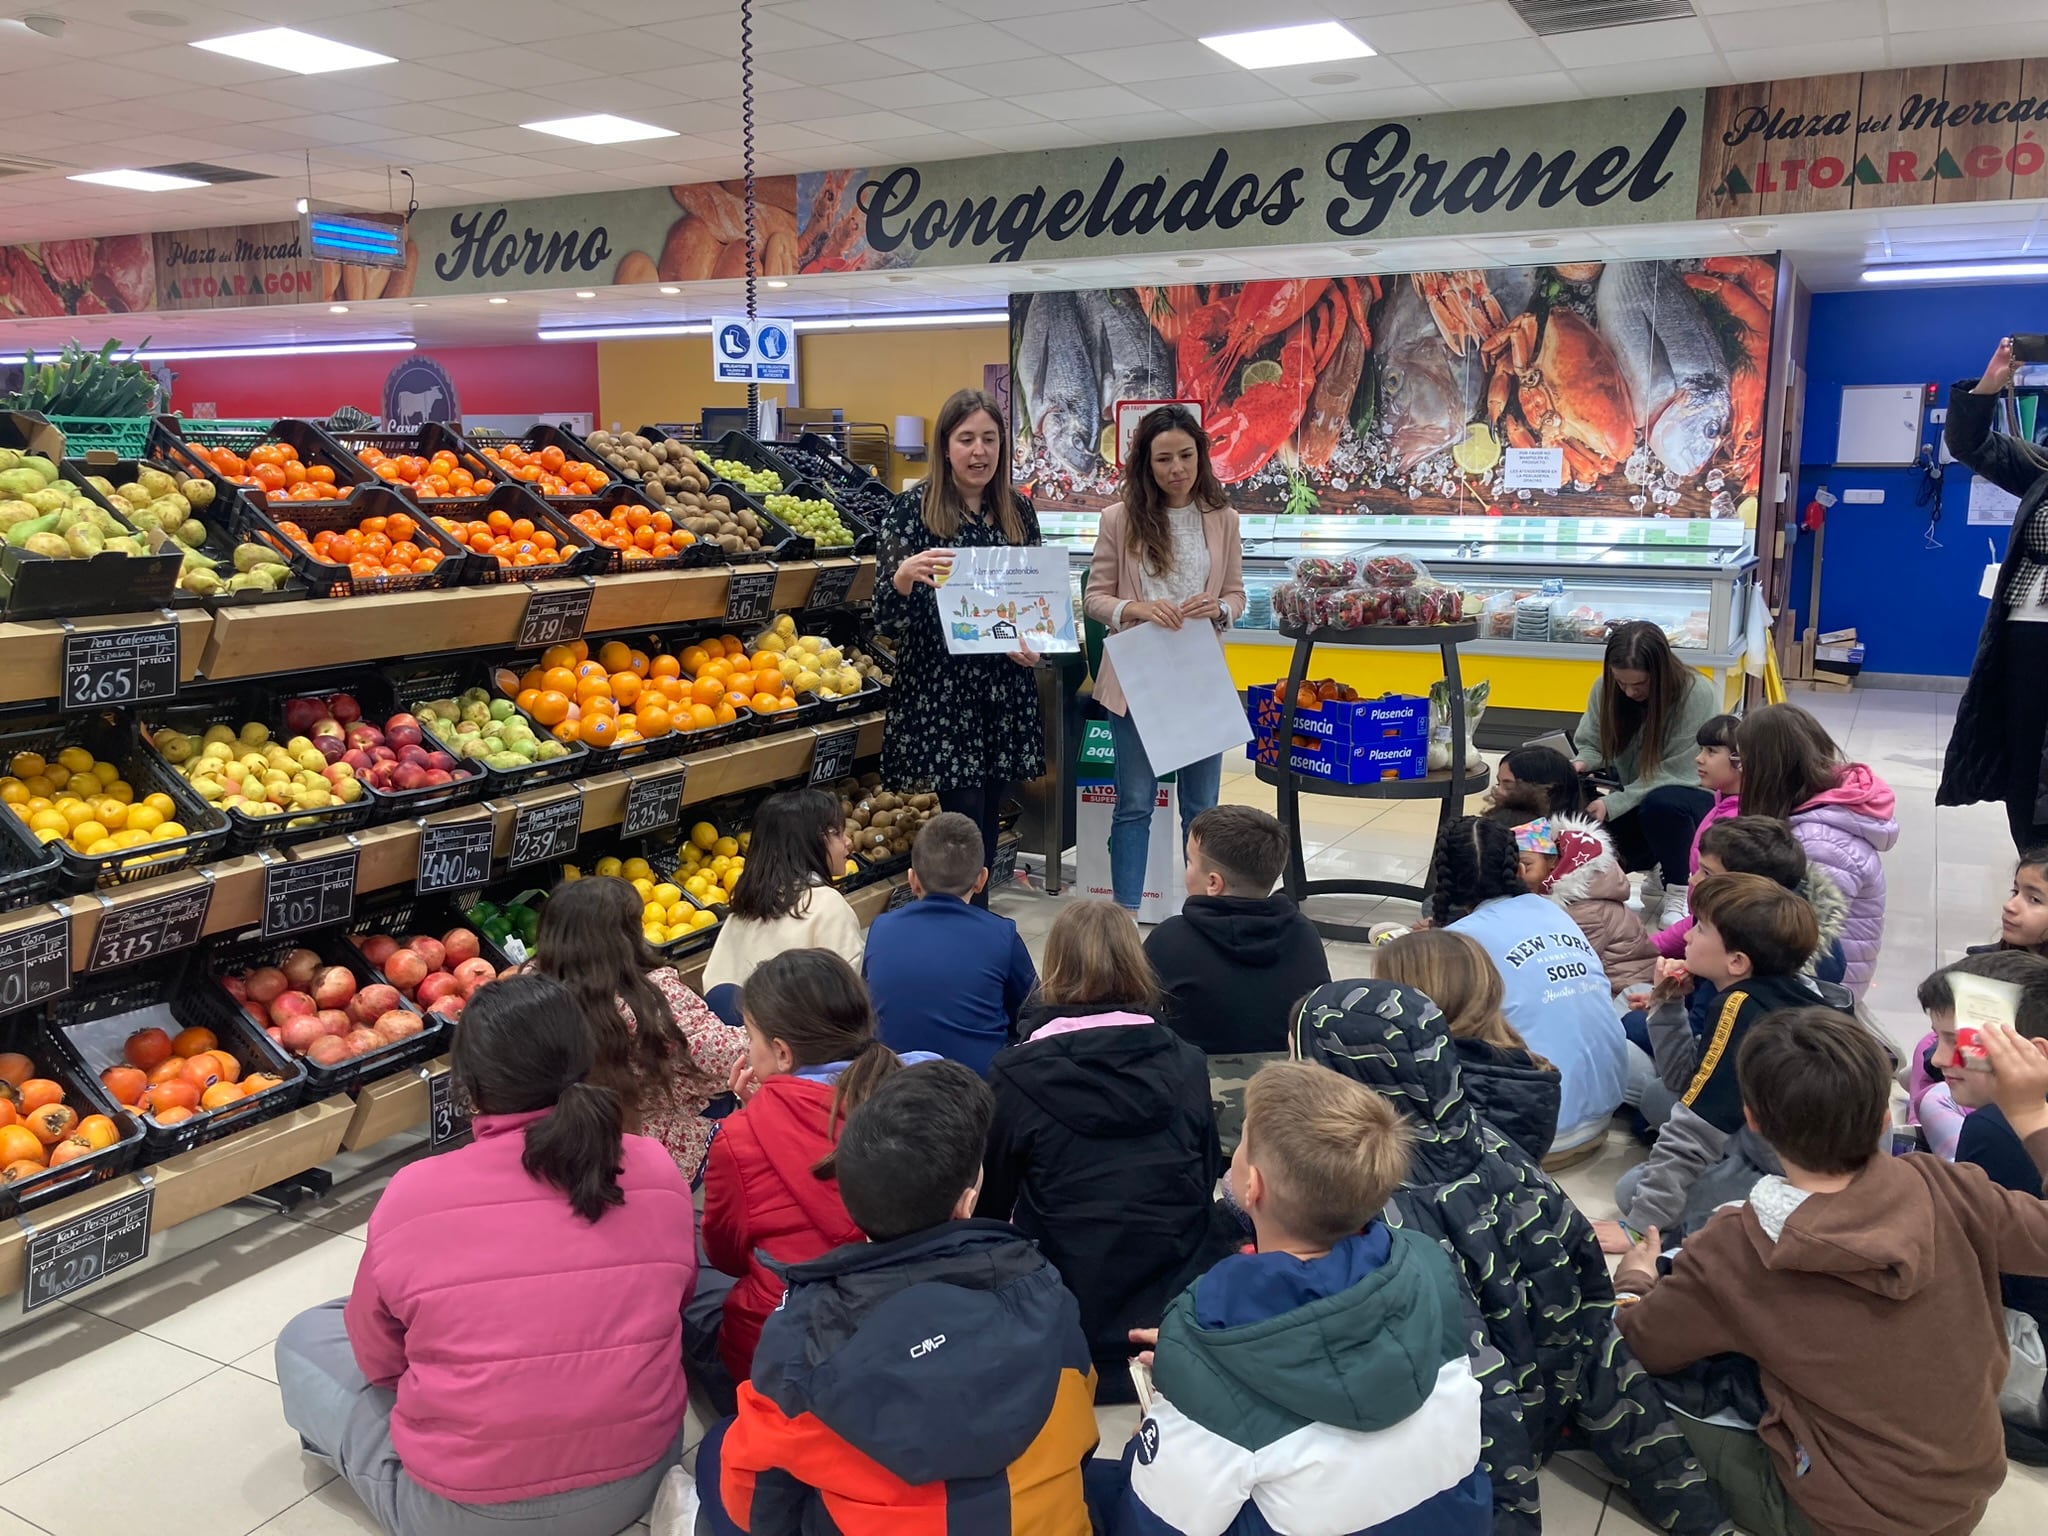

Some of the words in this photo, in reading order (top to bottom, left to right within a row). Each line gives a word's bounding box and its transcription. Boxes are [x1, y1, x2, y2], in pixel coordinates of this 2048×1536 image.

[1722, 105, 1852, 147] Plaza
[1857, 114, 1892, 134] del
[856, 147, 1304, 263] Congelados
[1325, 107, 1687, 236] Granel
[166, 242, 216, 267] Plaza
[218, 251, 232, 263] del
[235, 236, 302, 262] Mercad
[435, 208, 612, 283] Horno
[167, 264, 313, 299] ALTOARAGÓN
[69, 665, 91, 673] P.V.P.
[1371, 706, 1414, 720] Plasencia
[1369, 747, 1412, 761] Plasencia
[1290, 755, 1332, 775] asencia
[332, 881, 349, 889] TECLA
[39, 951, 62, 962] TECLA
[1506, 935, 1546, 968] NEW
[1548, 934, 1593, 957] YORK
[1547, 962, 1587, 982] SOHO
[56, 1227, 80, 1244] Kaki
[118, 1222, 141, 1236] TECLA
[33, 1261, 56, 1274] P.V.P.
[910, 1334, 946, 1358] CMP
